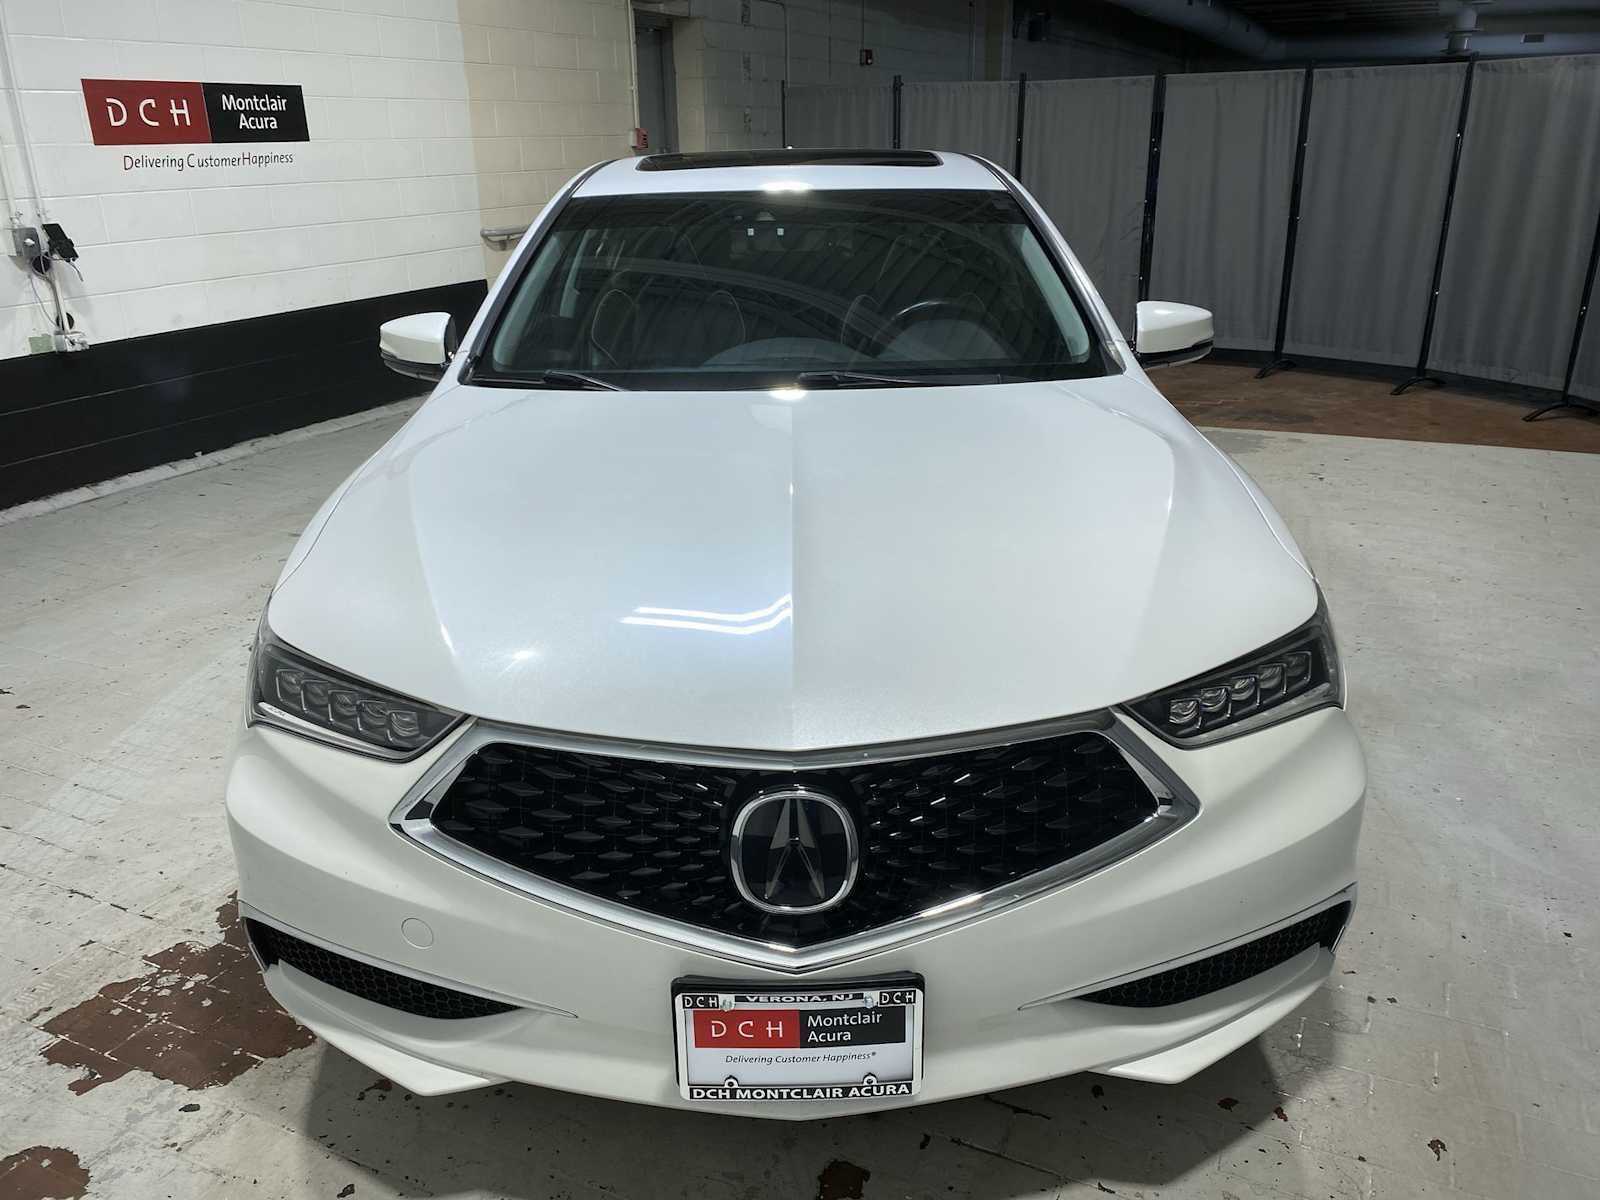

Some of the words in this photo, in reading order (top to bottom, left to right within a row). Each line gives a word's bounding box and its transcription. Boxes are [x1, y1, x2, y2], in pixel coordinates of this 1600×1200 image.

[221, 94, 288, 112] Montclair
[106, 97, 191, 127] DCH
[239, 113, 278, 129] Acura
[123, 155, 184, 171] Delivering
[684, 996, 718, 1008] DCH
[746, 995, 828, 1003] VERONA,
[881, 991, 914, 1004] DCH
[807, 1011, 882, 1028] Montclair
[711, 1020, 783, 1038] DCH
[807, 1030, 852, 1043] Acura
[725, 1055, 773, 1065] Delivering
[775, 1054, 820, 1063] Customer
[692, 1088, 730, 1099] DCH
[736, 1087, 843, 1099] MONTCLAIR
[847, 1084, 910, 1097] ACURA
